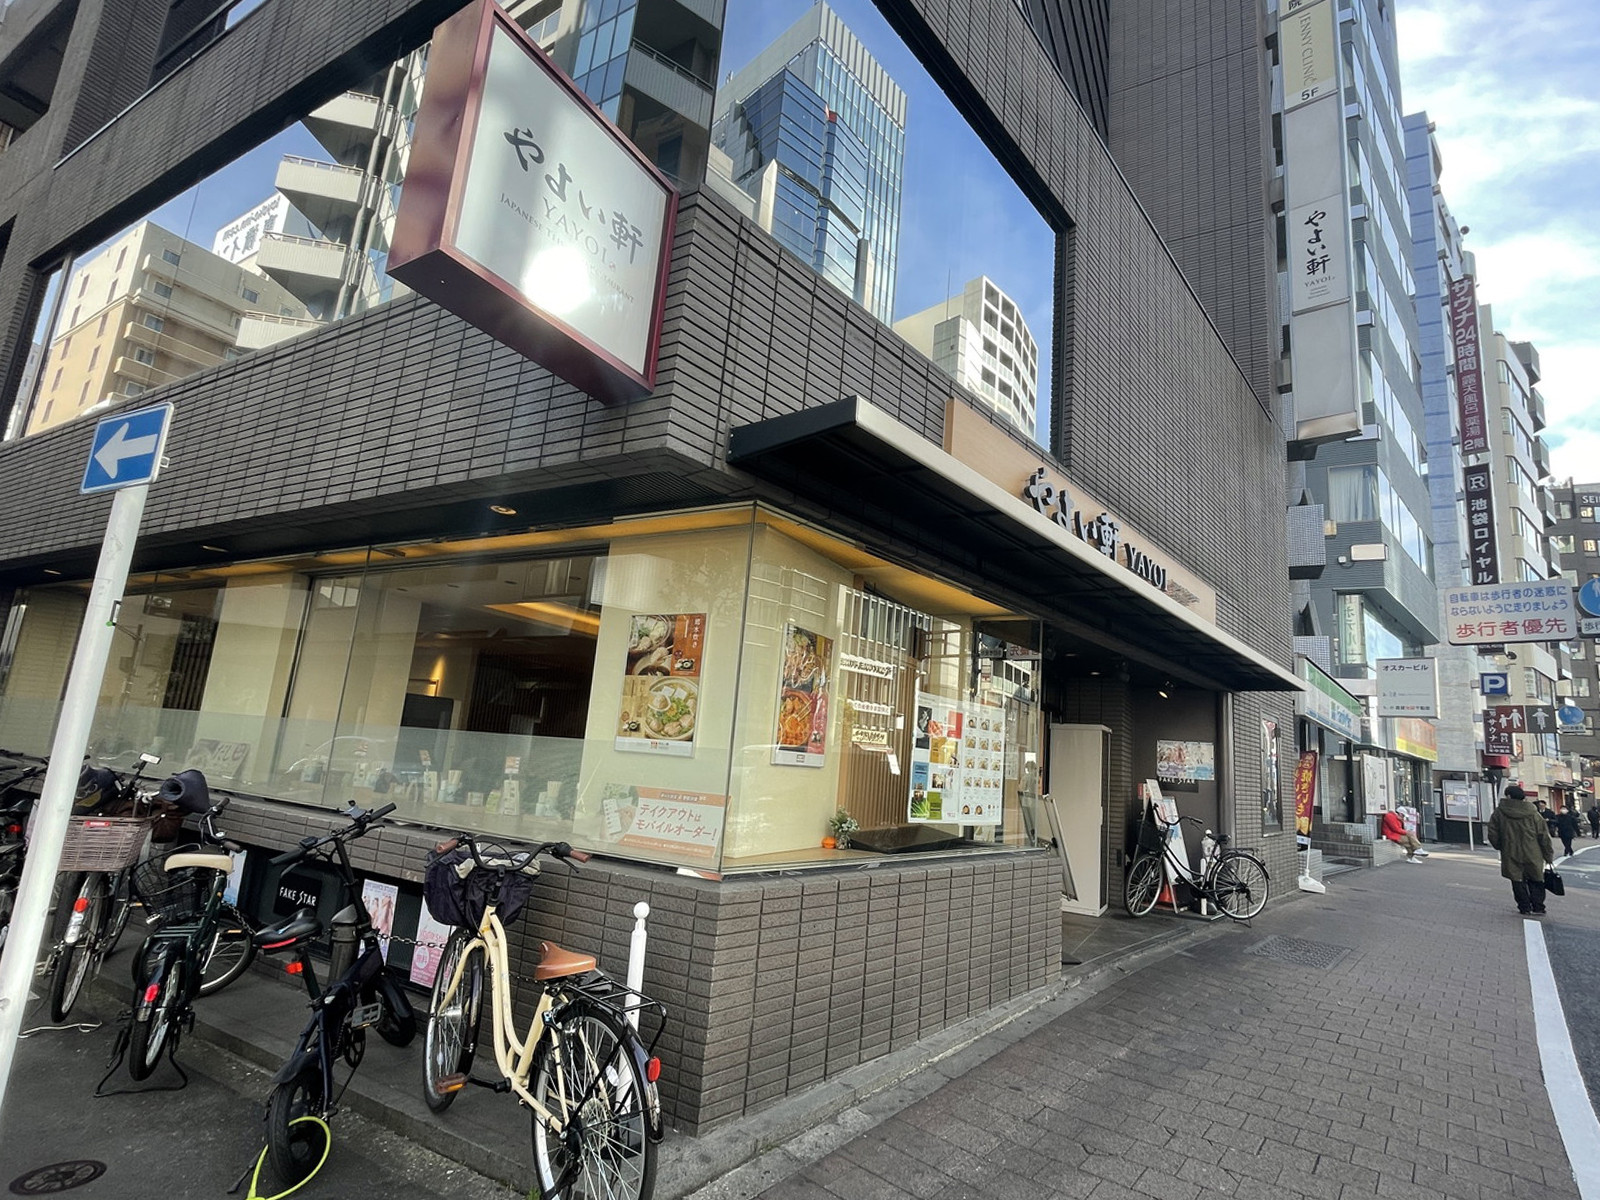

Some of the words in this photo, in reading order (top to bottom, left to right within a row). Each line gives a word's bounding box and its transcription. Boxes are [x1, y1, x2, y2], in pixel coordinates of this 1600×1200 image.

[1298, 12, 1313, 46] JENNY
[1301, 47, 1317, 87] CLINIC
[1301, 87, 1319, 101] 5F
[504, 127, 643, 264] やよい軒
[543, 196, 607, 264] YAYOI
[1304, 210, 1331, 275] やよい軒
[1304, 275, 1332, 287] YAYOI
[1470, 476, 1485, 490] R
[1582, 495, 1600, 504] SEI
[1023, 467, 1121, 563] やよい軒
[1471, 497, 1493, 583] 池袋ロイヤル
[1124, 543, 1168, 591] YAYOI
[1450, 586, 1568, 604] 自転車は歩行者の迷惑に
[1450, 600, 1568, 616] ならないように走りましょう
[1456, 617, 1567, 638] 歩行者優先
[1485, 677, 1505, 692] P
[640, 804, 701, 822] テイクアウトは
[636, 819, 718, 841] モバイルオーダー!
[279, 886, 296, 900] FAKE
[298, 890, 317, 907] STAR
